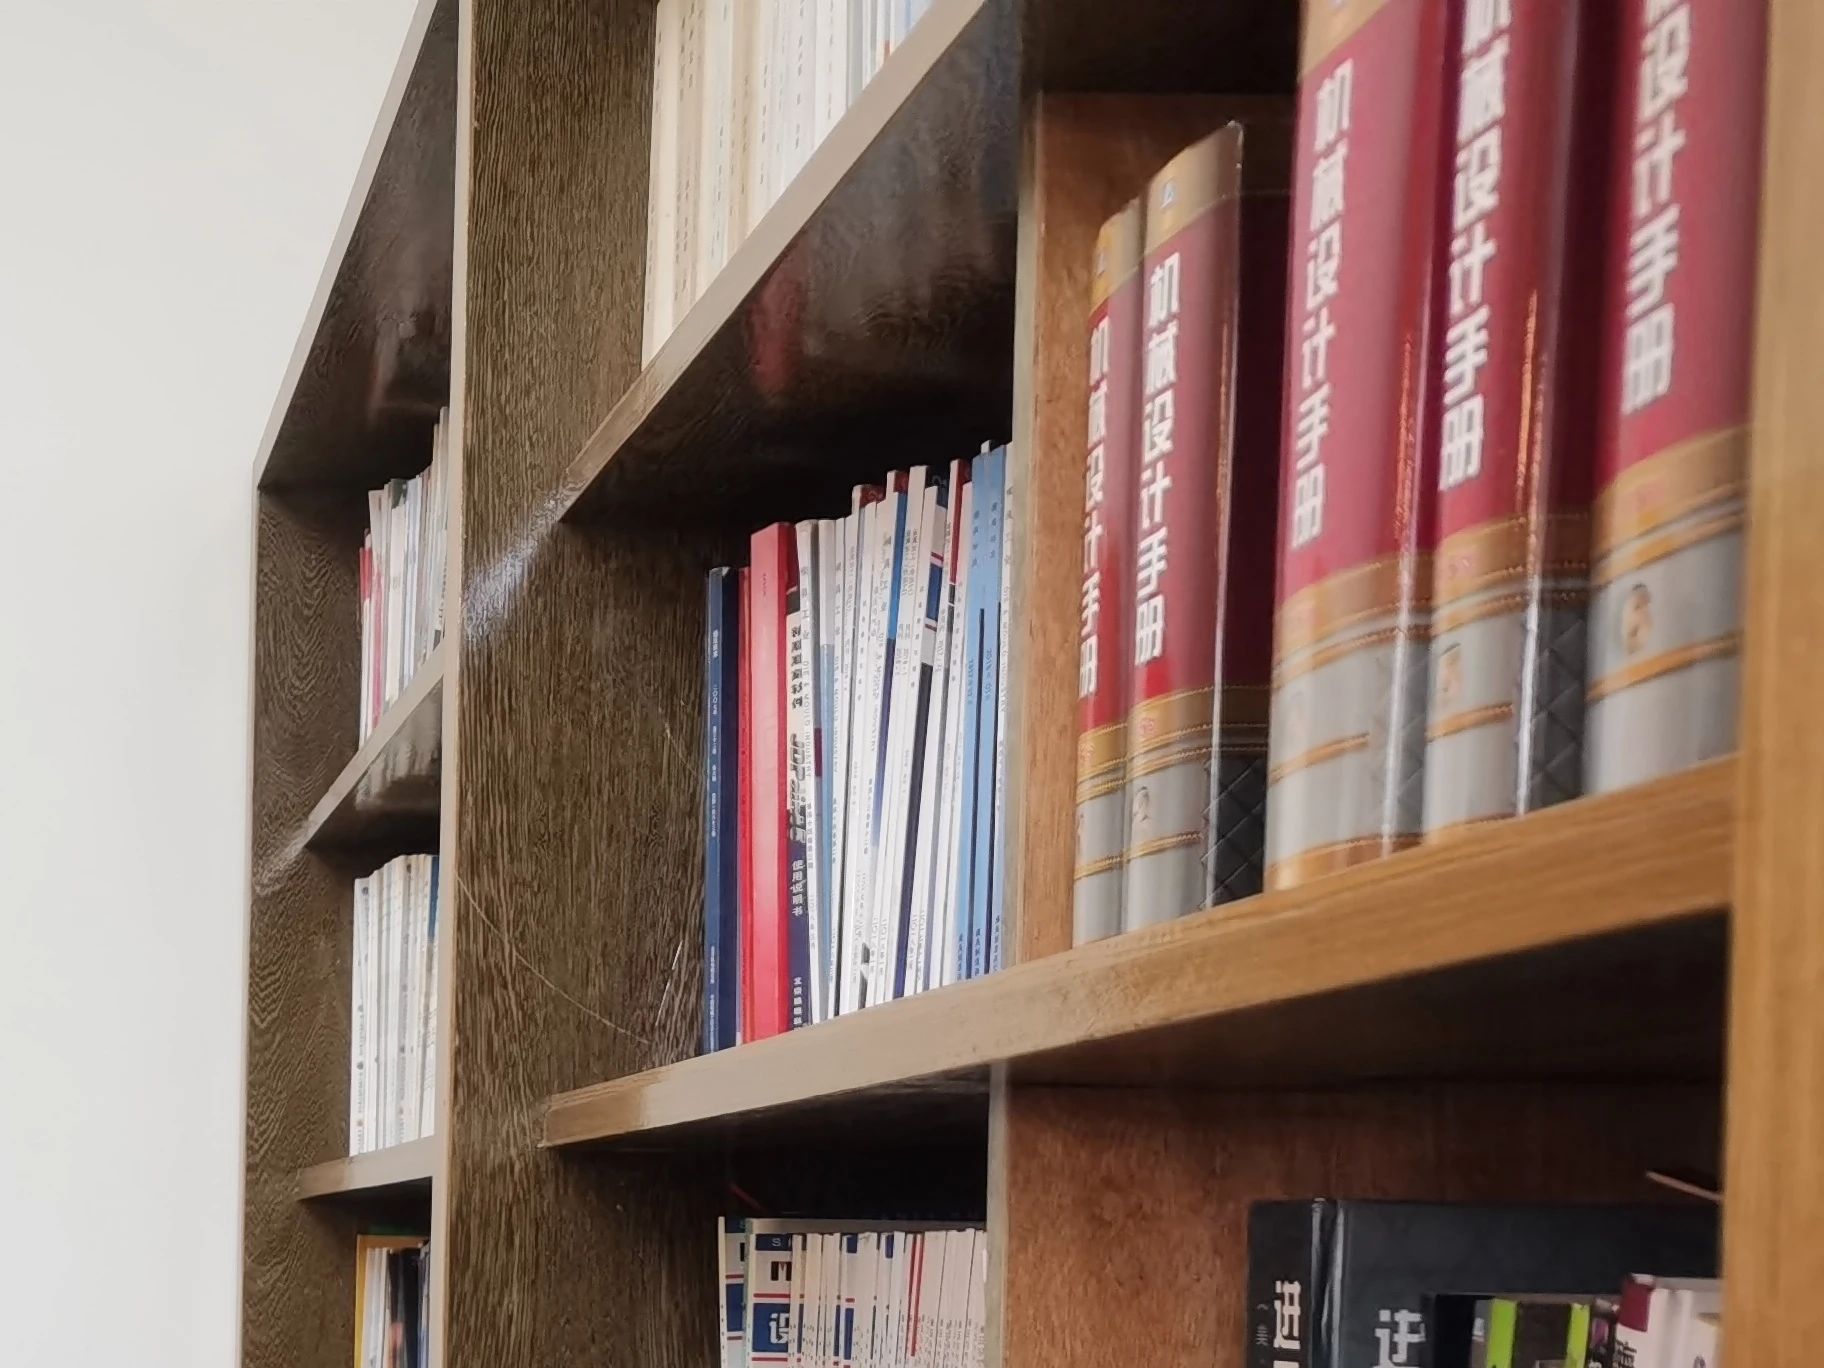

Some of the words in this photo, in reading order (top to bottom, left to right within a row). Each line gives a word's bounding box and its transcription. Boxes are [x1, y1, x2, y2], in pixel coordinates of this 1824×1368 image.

[1078, 314, 1111, 698] 机械设计手册
[1133, 252, 1182, 669] 机械设计手册
[1290, 58, 1354, 550] 机械设计手册
